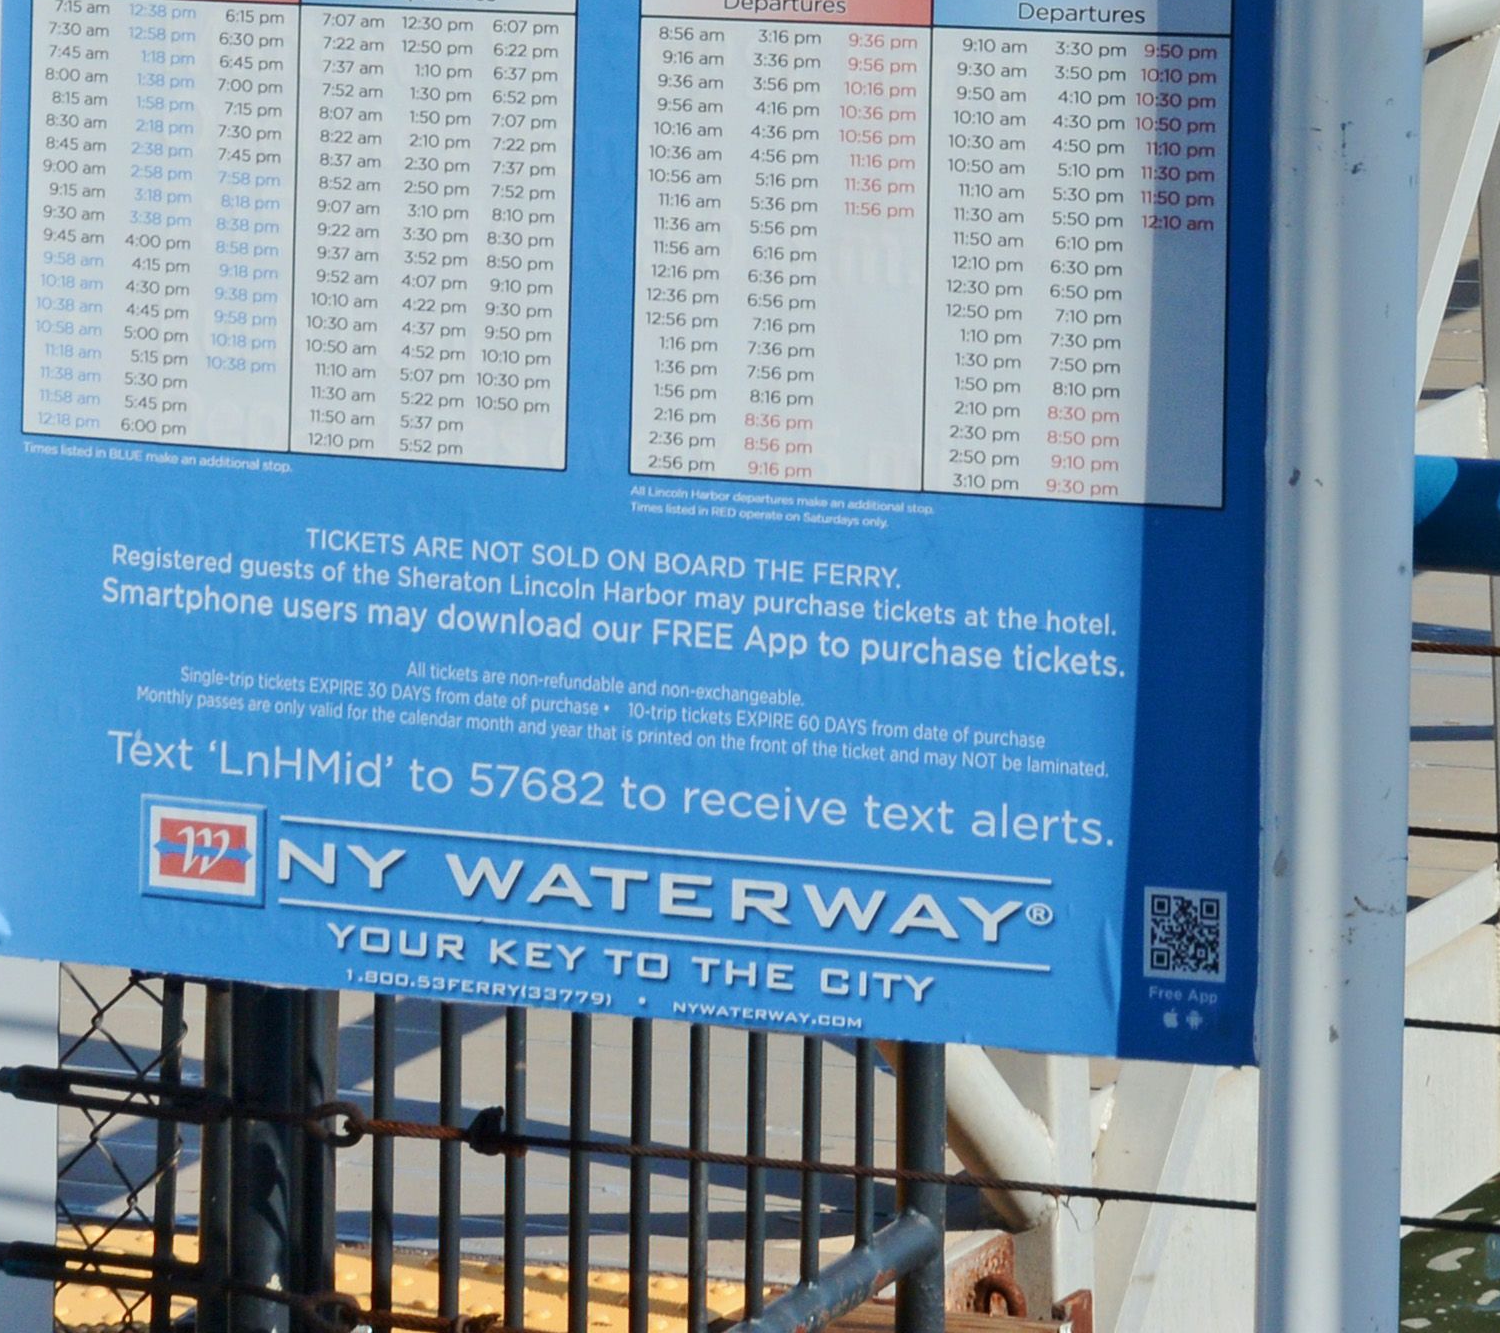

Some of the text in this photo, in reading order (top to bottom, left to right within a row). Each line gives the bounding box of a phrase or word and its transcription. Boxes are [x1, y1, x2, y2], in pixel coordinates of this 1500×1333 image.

[55, 0, 110, 15] 7:15 am
[226, 9, 285, 27] 6:15 pm
[1018, 2, 1147, 27] Departures
[322, 13, 385, 29] 7:07 am
[659, 27, 725, 43] 8:56 am
[953, 473, 1019, 493] 3:10 pm
[306, 528, 901, 590] TICKETS ARE NOT SOLD ON BOARD THE FERRY.
[112, 544, 1116, 636] Registered guests of the Sheraton Lincoln Harbor may purchase tickets at the hotel.
[102, 577, 1126, 678] Smartphone users may download our FREE App to purchase tickets.
[108, 731, 192, 771] Text
[410, 758, 453, 793] to
[469, 763, 604, 808] 57682
[621, 776, 666, 812] to
[683, 786, 848, 827] receive
[865, 794, 954, 835] text
[971, 802, 1115, 847] alerts.
[279, 839, 407, 890] NY
[328, 922, 936, 1004] YOUR KEY TO THE CITY
[1149, 987, 1218, 1007] Free App
